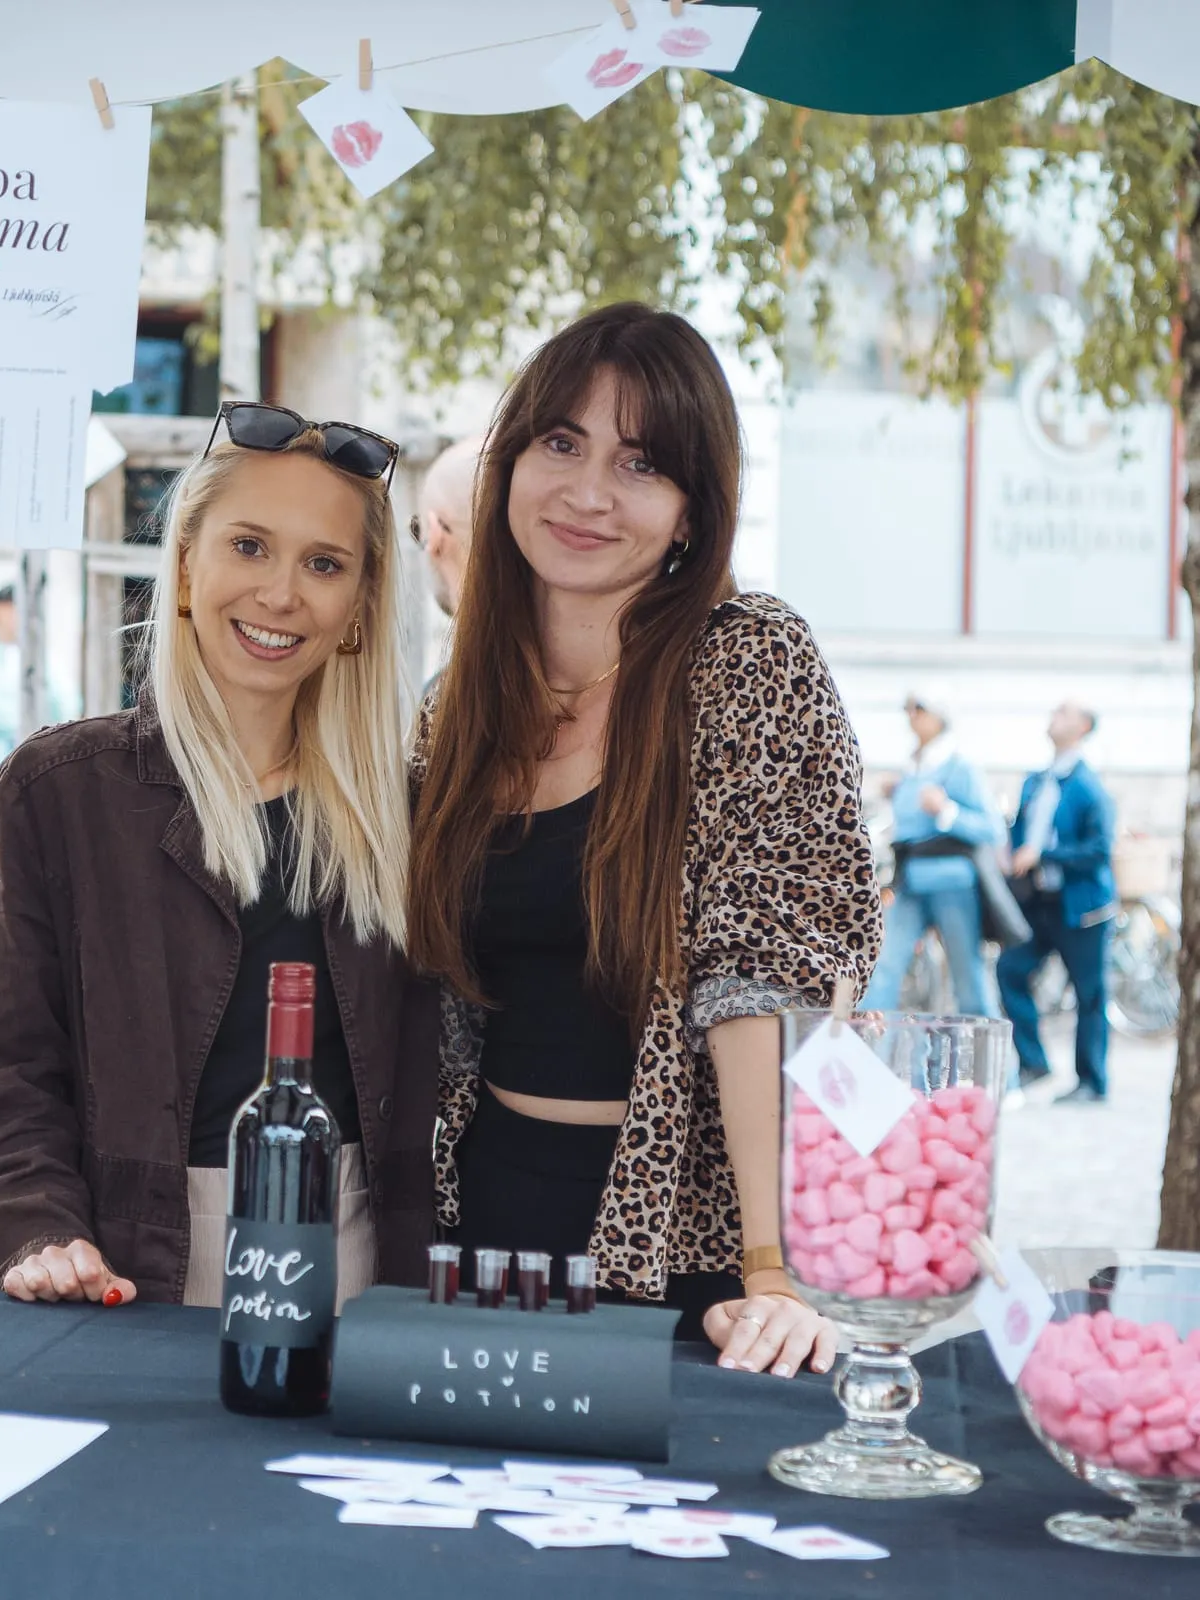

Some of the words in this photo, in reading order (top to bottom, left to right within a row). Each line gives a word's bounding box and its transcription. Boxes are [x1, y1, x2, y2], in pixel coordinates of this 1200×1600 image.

[225, 1290, 312, 1332] potion
[443, 1347, 550, 1374] LOVE
[410, 1382, 591, 1414] POTION
